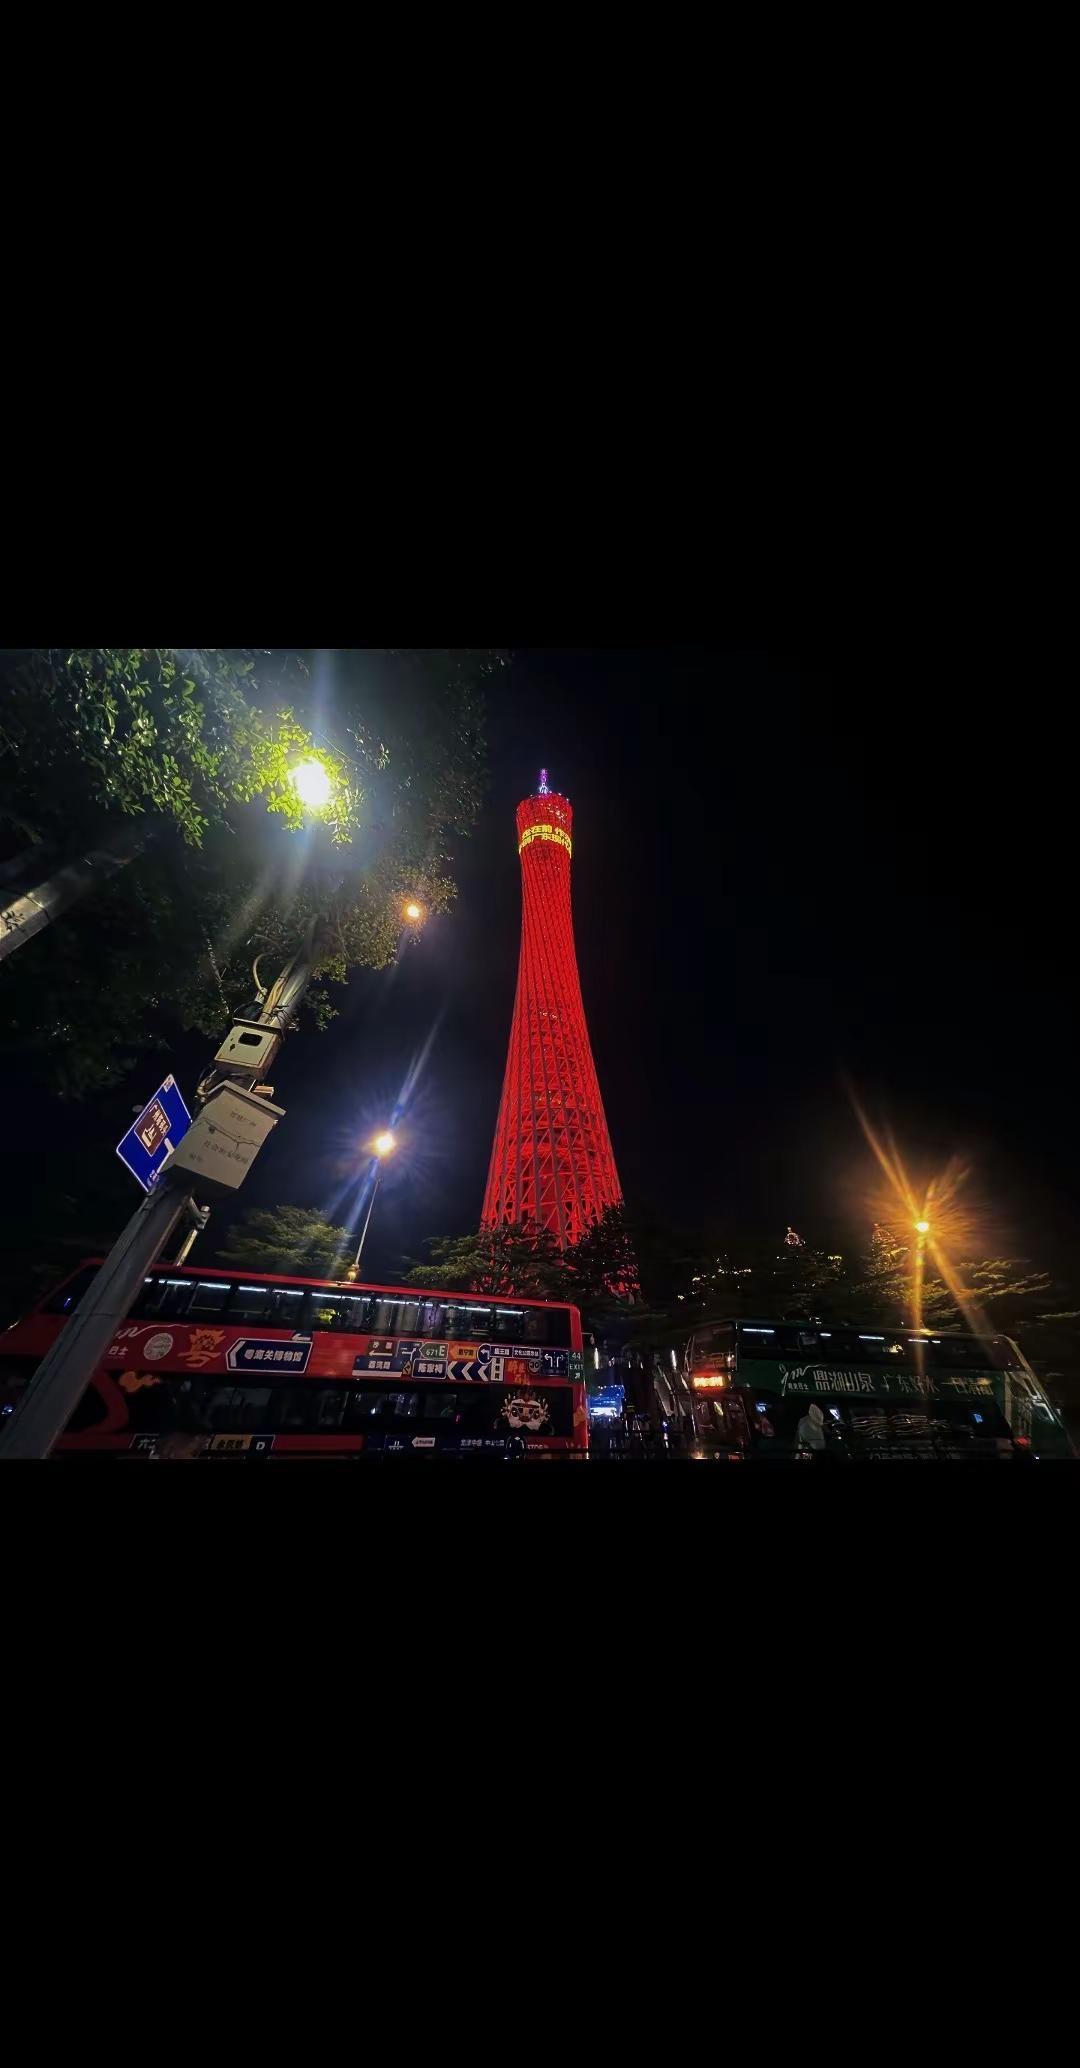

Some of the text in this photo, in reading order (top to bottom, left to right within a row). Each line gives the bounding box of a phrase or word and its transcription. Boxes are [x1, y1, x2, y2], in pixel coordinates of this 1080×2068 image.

[243, 1348, 304, 1362] 粤海关博物馆
[569, 1363, 584, 1371] EXIT
[812, 1369, 877, 1392] 鼎湖山泉
[255, 1441, 266, 1450] D
